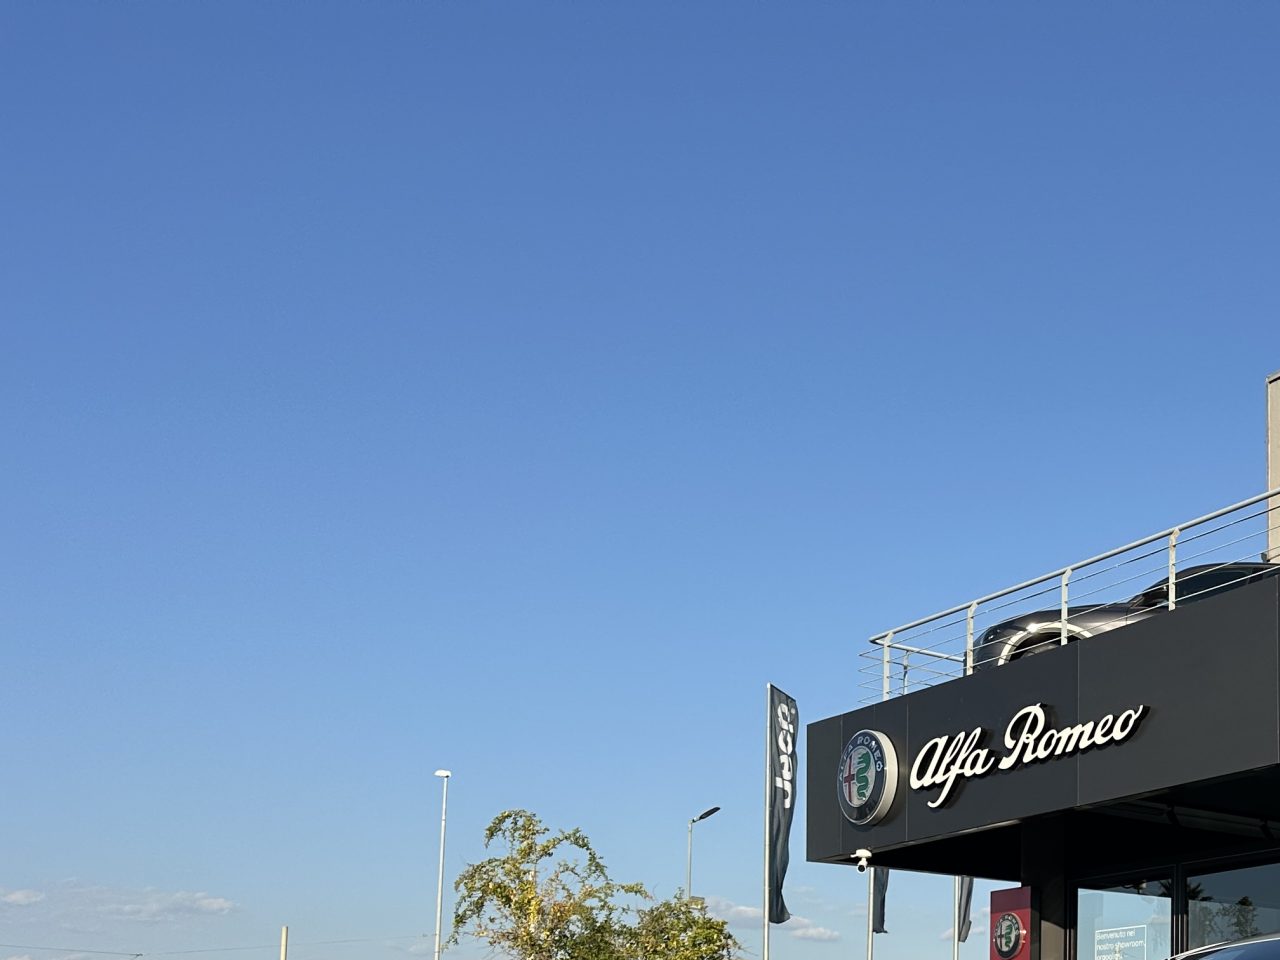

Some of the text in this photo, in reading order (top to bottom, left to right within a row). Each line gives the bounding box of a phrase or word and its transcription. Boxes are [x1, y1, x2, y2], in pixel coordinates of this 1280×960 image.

[857, 736, 883, 772] ROMEO
[910, 703, 1144, 808] Alfa Romeo
